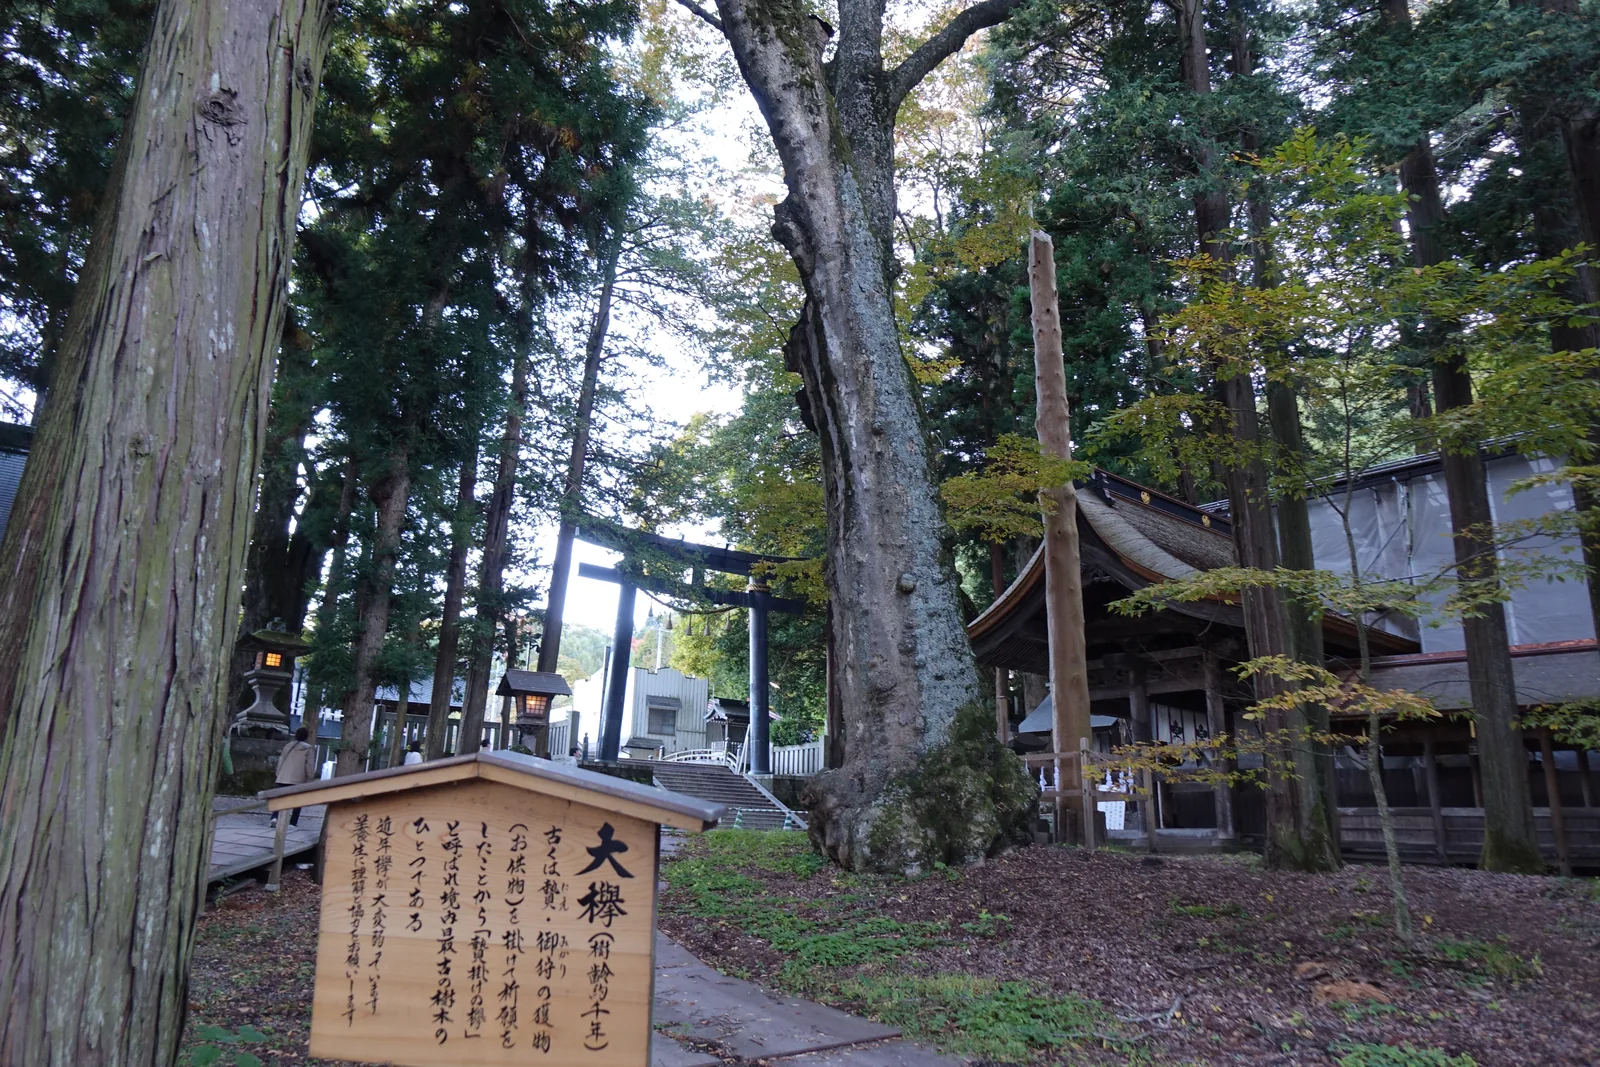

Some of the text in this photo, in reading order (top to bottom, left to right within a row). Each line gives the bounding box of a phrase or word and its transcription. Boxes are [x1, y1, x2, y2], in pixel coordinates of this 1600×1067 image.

[364, 815, 395, 1016] 近年欅が大変弱っています
[405, 816, 431, 933] ひとつである
[429, 819, 464, 1045] と呼ばれ境内最古の樹木の
